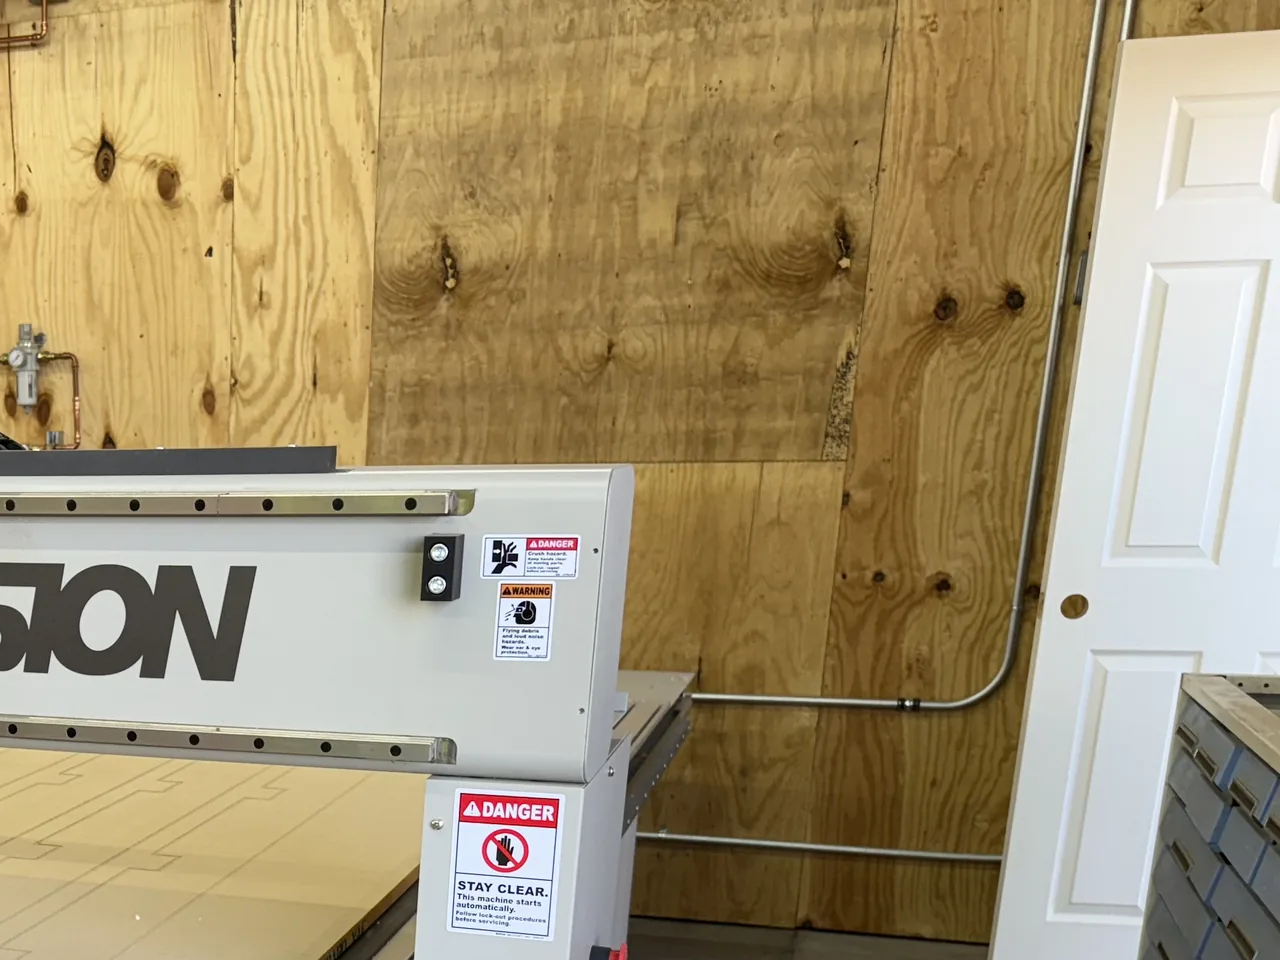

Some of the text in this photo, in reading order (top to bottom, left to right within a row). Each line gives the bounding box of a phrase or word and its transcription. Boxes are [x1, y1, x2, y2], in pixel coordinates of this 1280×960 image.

[538, 540, 574, 548] DANGER
[512, 586, 550, 596] WARNING
[482, 801, 555, 822] DANGER
[457, 880, 549, 897] STAY CLEAR.
[457, 893, 542, 907] This machine starts
[456, 901, 516, 913] automatically.
[478, 912, 506, 920] lock-out
[507, 915, 547, 924] procedures
